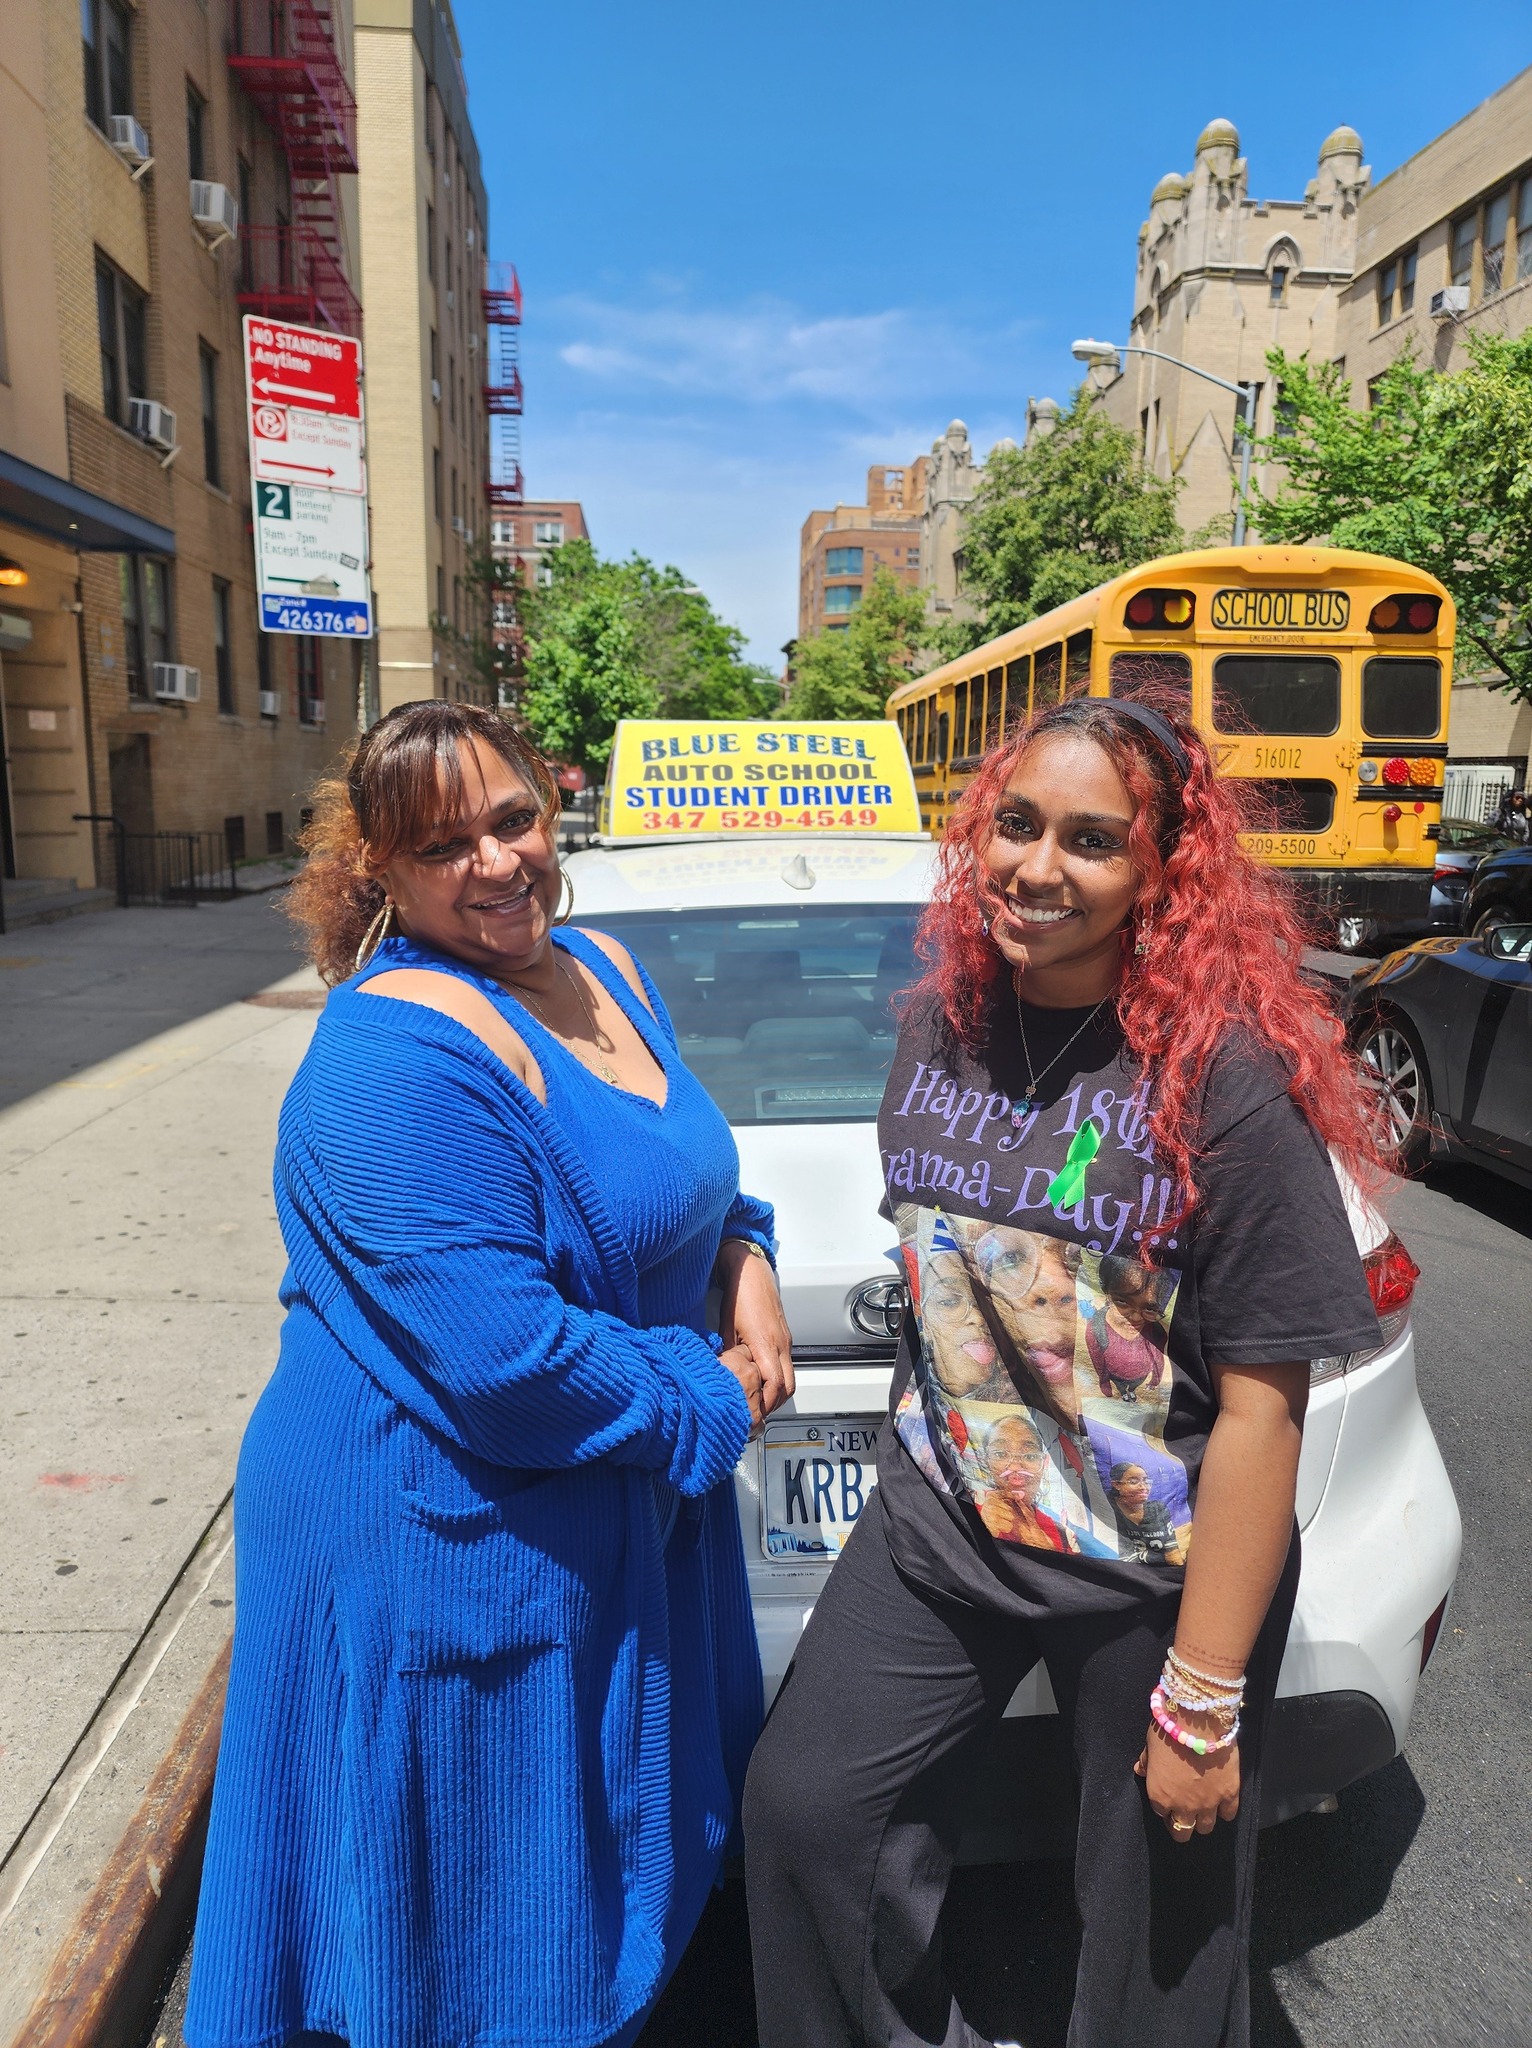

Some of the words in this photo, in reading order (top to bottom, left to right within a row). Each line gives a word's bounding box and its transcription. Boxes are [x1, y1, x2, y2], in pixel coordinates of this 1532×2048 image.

[252, 327, 274, 347] NO
[275, 331, 343, 361] STANDING
[254, 346, 312, 373] Anytime
[264, 485, 285, 518] 2
[277, 608, 344, 633] 426376
[1216, 591, 1299, 625] SCHOOL
[1305, 593, 1349, 626] BUS
[641, 733, 741, 763] BLUE
[757, 732, 876, 761] STEEL
[1255, 747, 1302, 769] 516012
[643, 764, 734, 782] AUTO
[744, 763, 878, 781] SCHOOL
[625, 786, 770, 808] STUDENT
[780, 785, 893, 806] DRIVER
[643, 811, 705, 830] 347
[720, 809, 878, 829] 529-4549
[893, 1061, 1045, 1152] Happy
[1052, 1080, 1157, 1165] 18th
[828, 1431, 878, 1452] NEW
